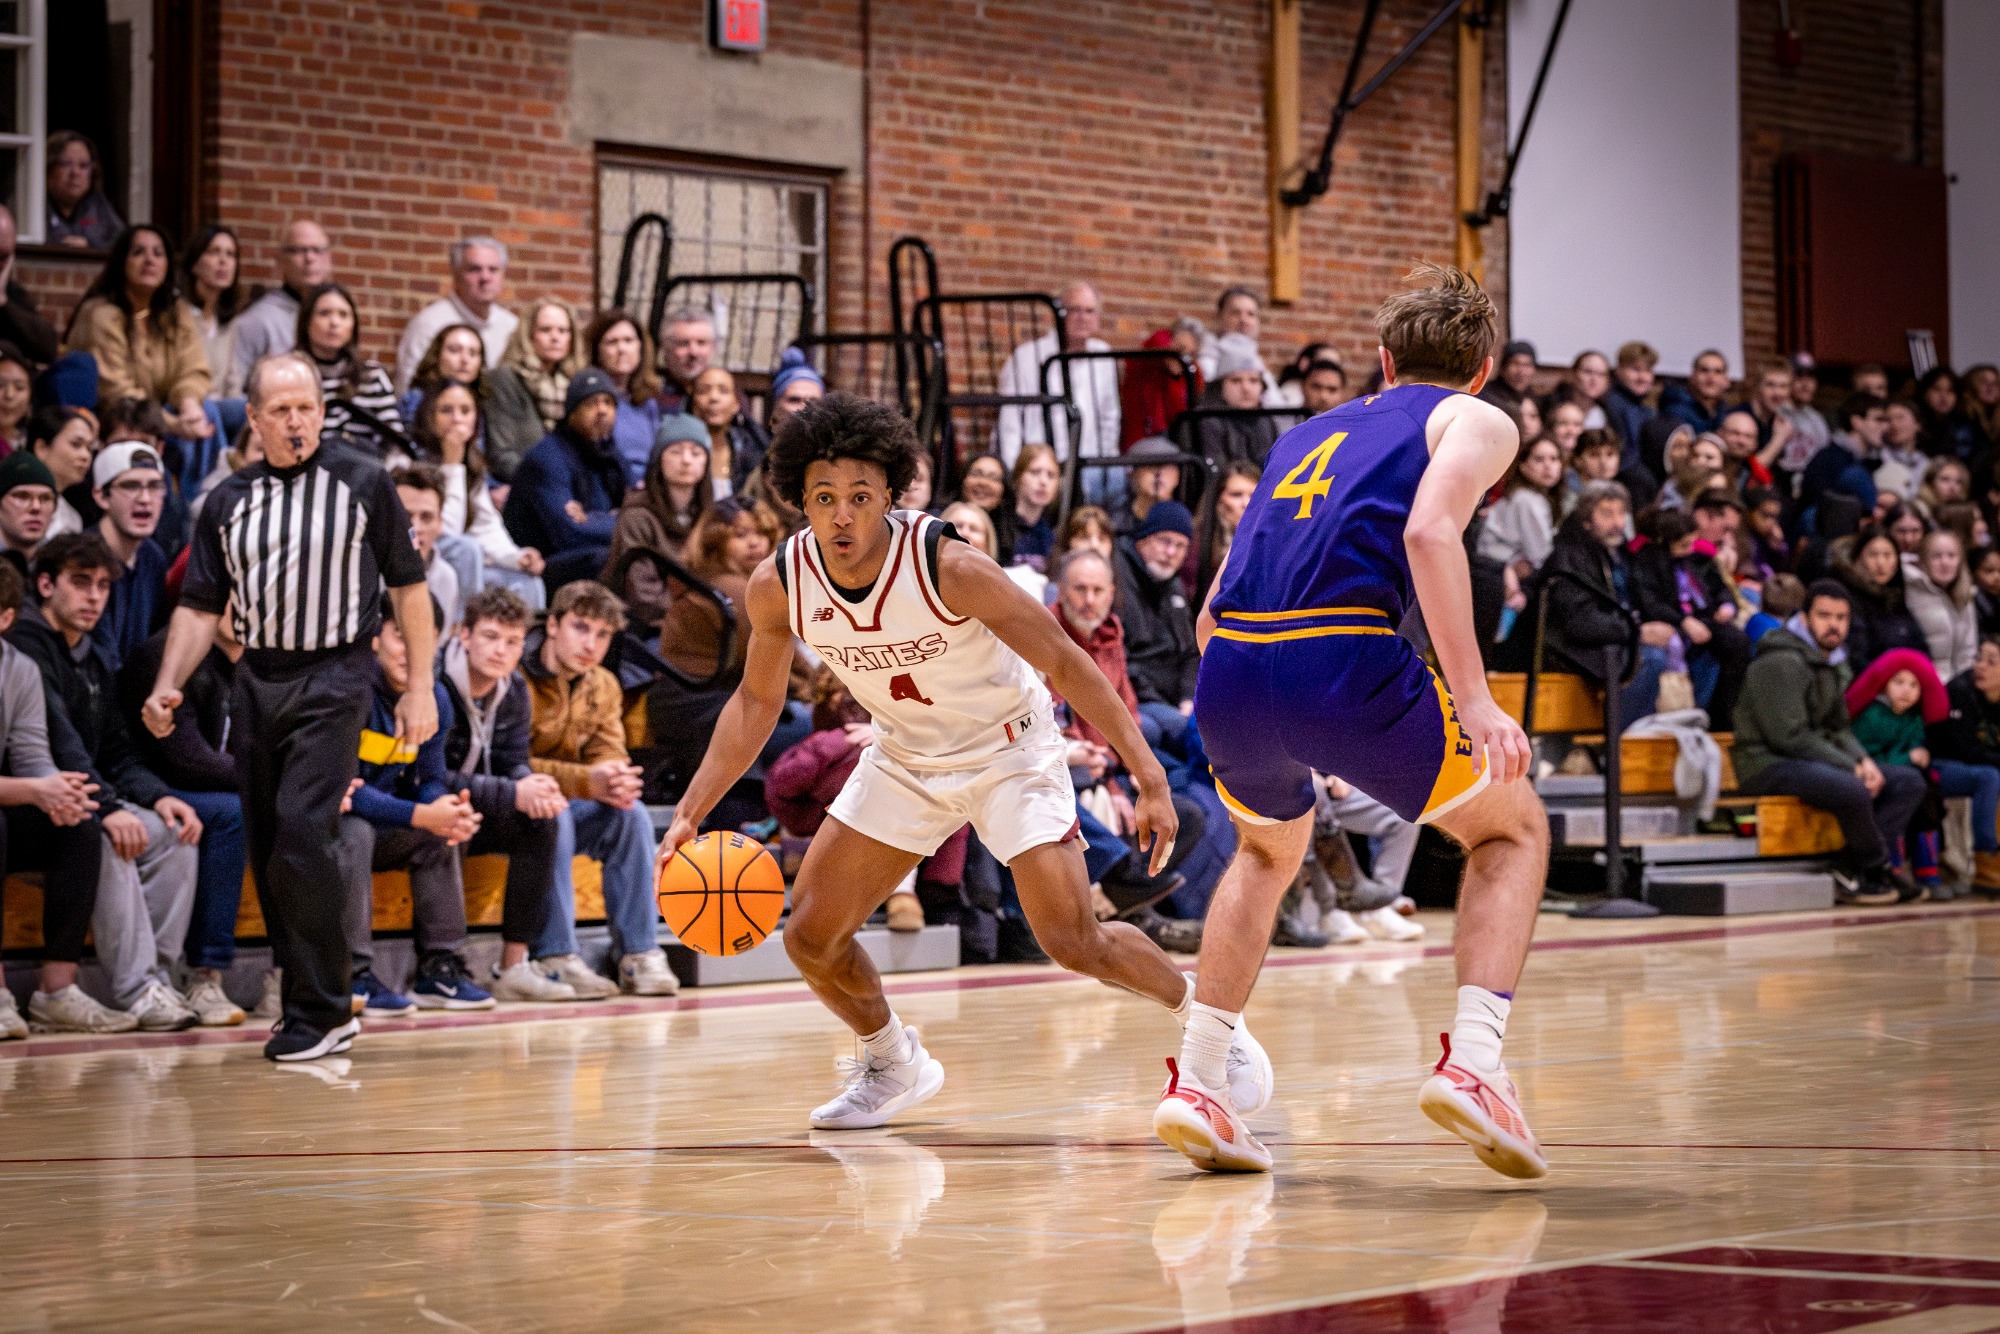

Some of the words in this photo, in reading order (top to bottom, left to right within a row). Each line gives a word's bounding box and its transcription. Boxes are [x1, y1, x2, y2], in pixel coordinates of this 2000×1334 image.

[1272, 432, 1349, 520] 4
[813, 632, 948, 671] BATES
[889, 673, 934, 706] 4
